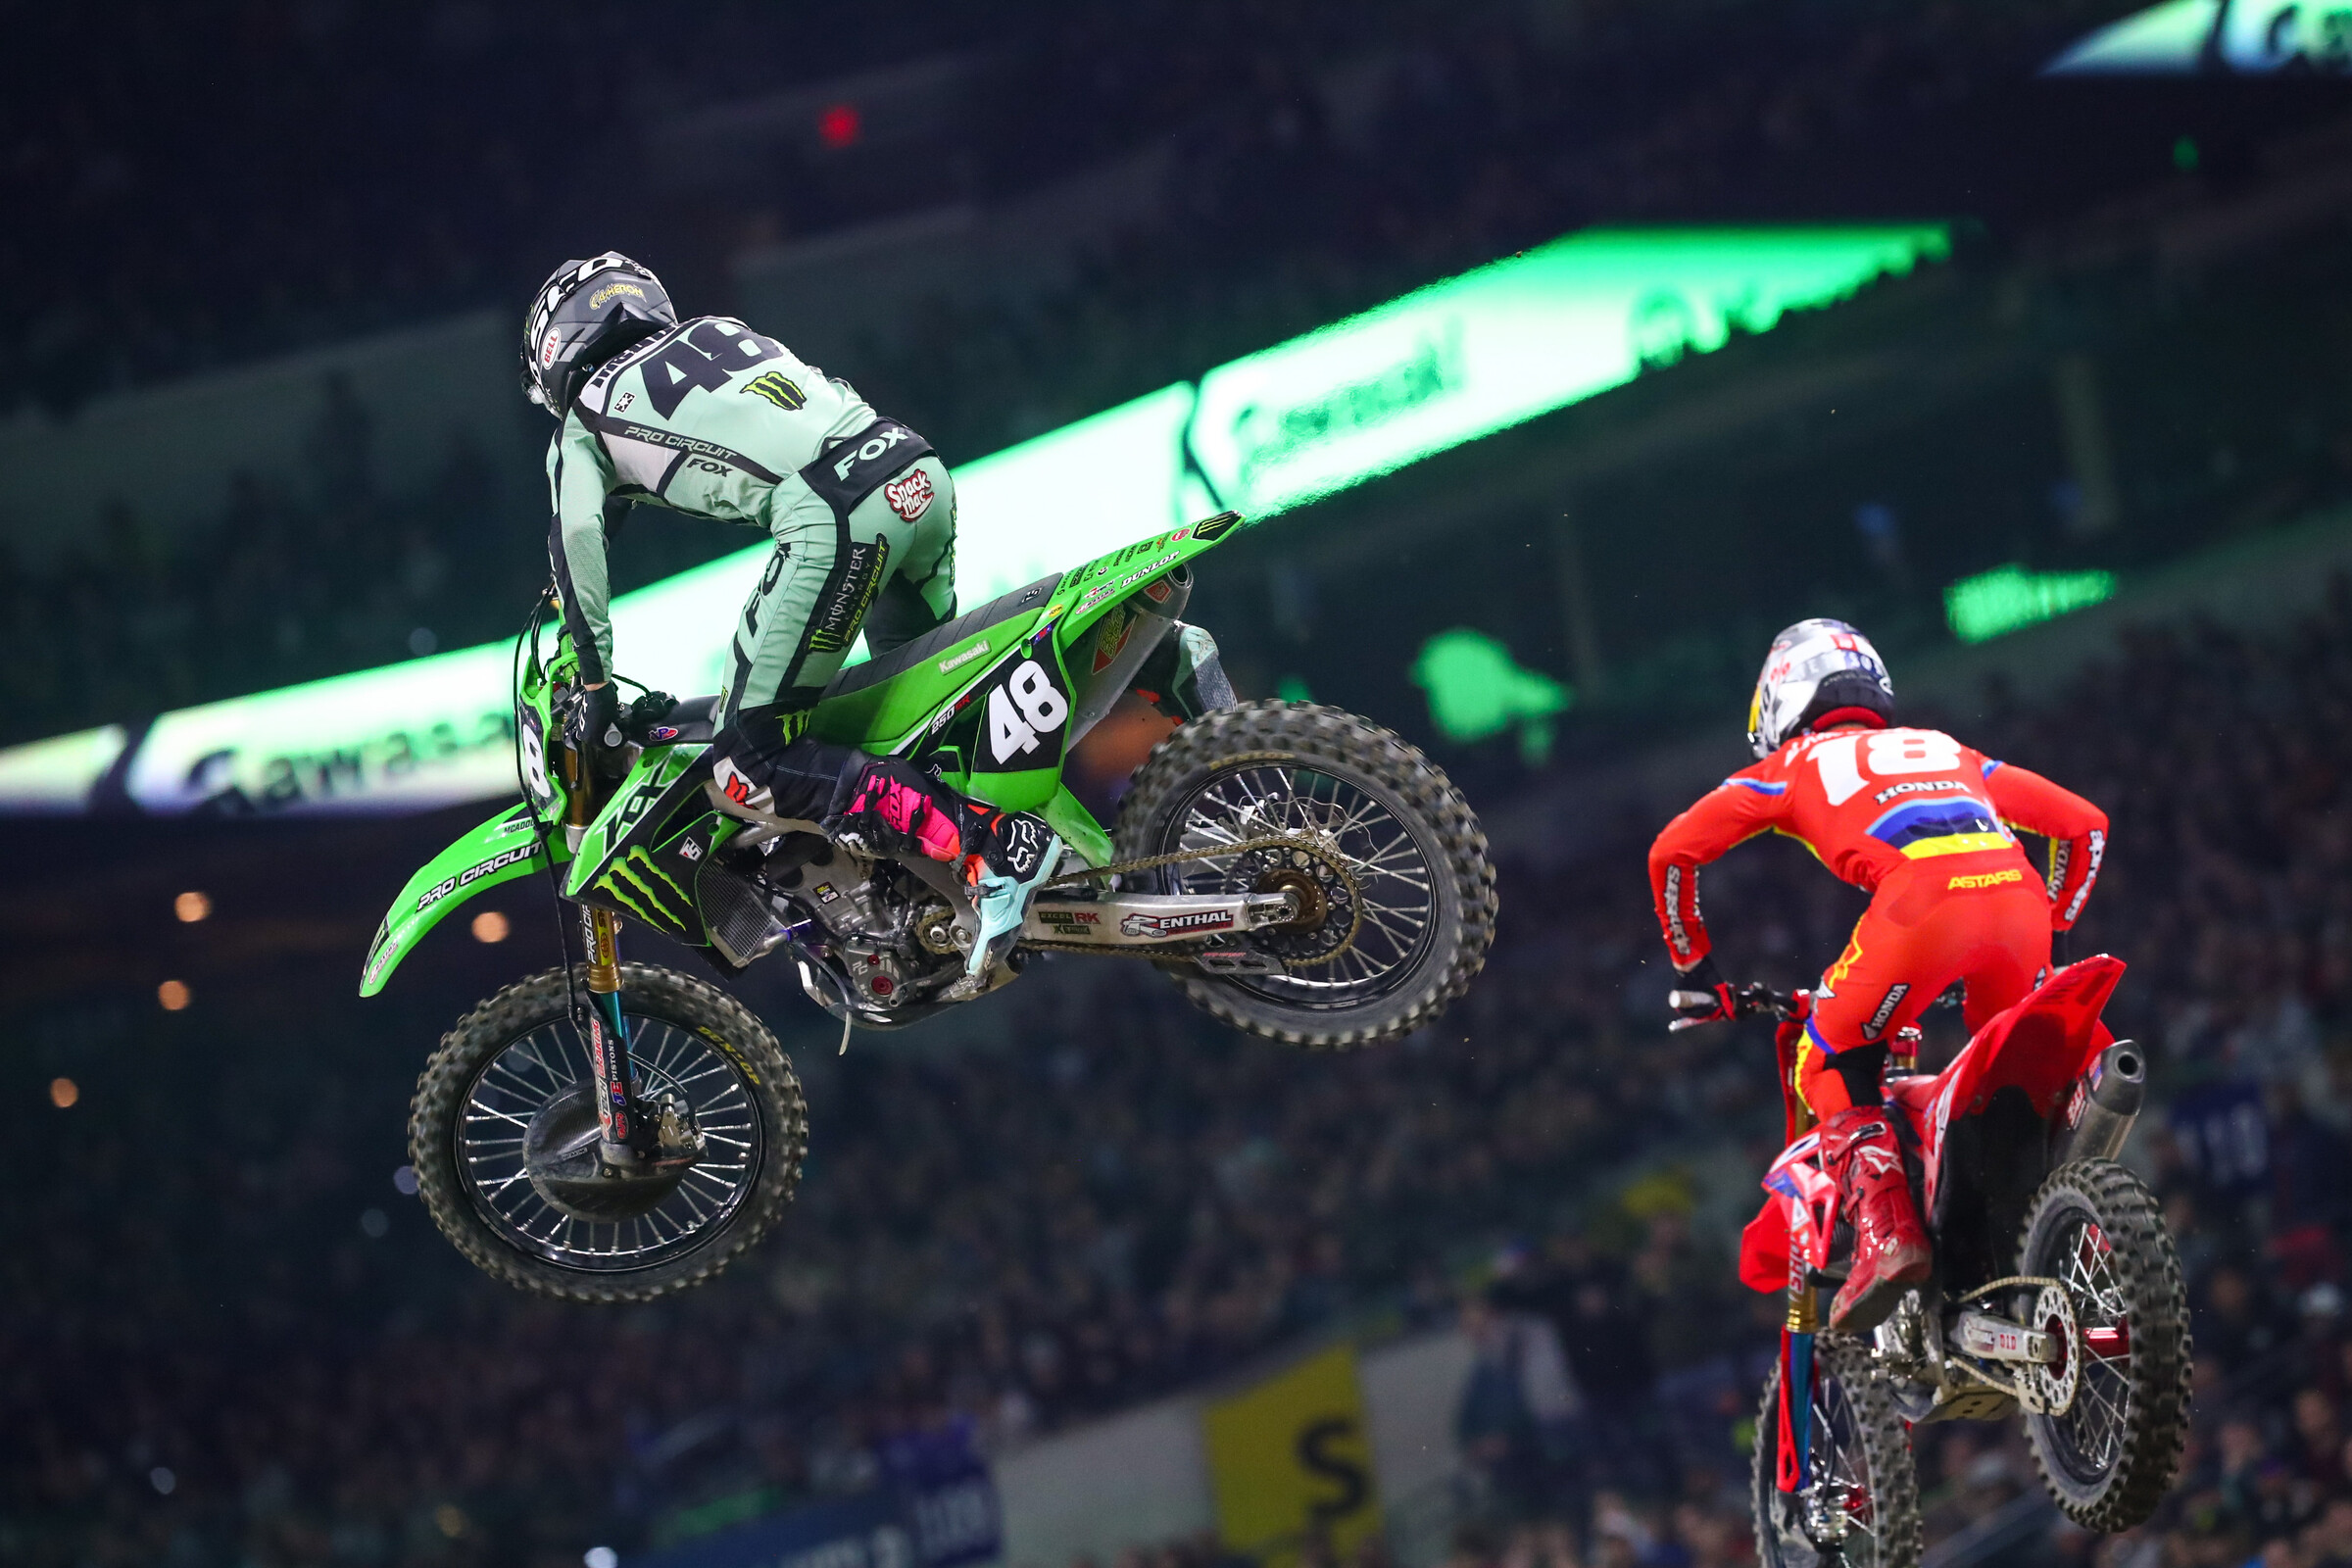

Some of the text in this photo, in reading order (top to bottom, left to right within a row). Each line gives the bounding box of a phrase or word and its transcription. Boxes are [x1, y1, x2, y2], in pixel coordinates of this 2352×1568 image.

[590, 283, 647, 310] CAMERON
[544, 335, 559, 364] BELL
[639, 320, 784, 420] 48
[624, 425, 737, 461] PRO CIRCUIT
[833, 427, 909, 481] FOX
[686, 458, 734, 478] FOX
[887, 471, 931, 510] Snack
[1121, 550, 1180, 588] DUNLOP
[825, 547, 866, 631] MONSTER
[844, 539, 887, 642] PRO CIRCUIT
[938, 640, 990, 673] Kawasaki
[988, 660, 1069, 765] 48
[522, 722, 552, 799] 8
[1806, 730, 1962, 807] 18
[1875, 780, 1973, 806] HONDA
[416, 842, 543, 911] PRO CIRCUIT
[1947, 869, 2023, 891] ASTARS
[1074, 912, 1102, 924] RK
[585, 926, 597, 965] PRO
[1871, 984, 1909, 1029] HONDA
[608, 1039, 627, 1106] JE PISTONS
